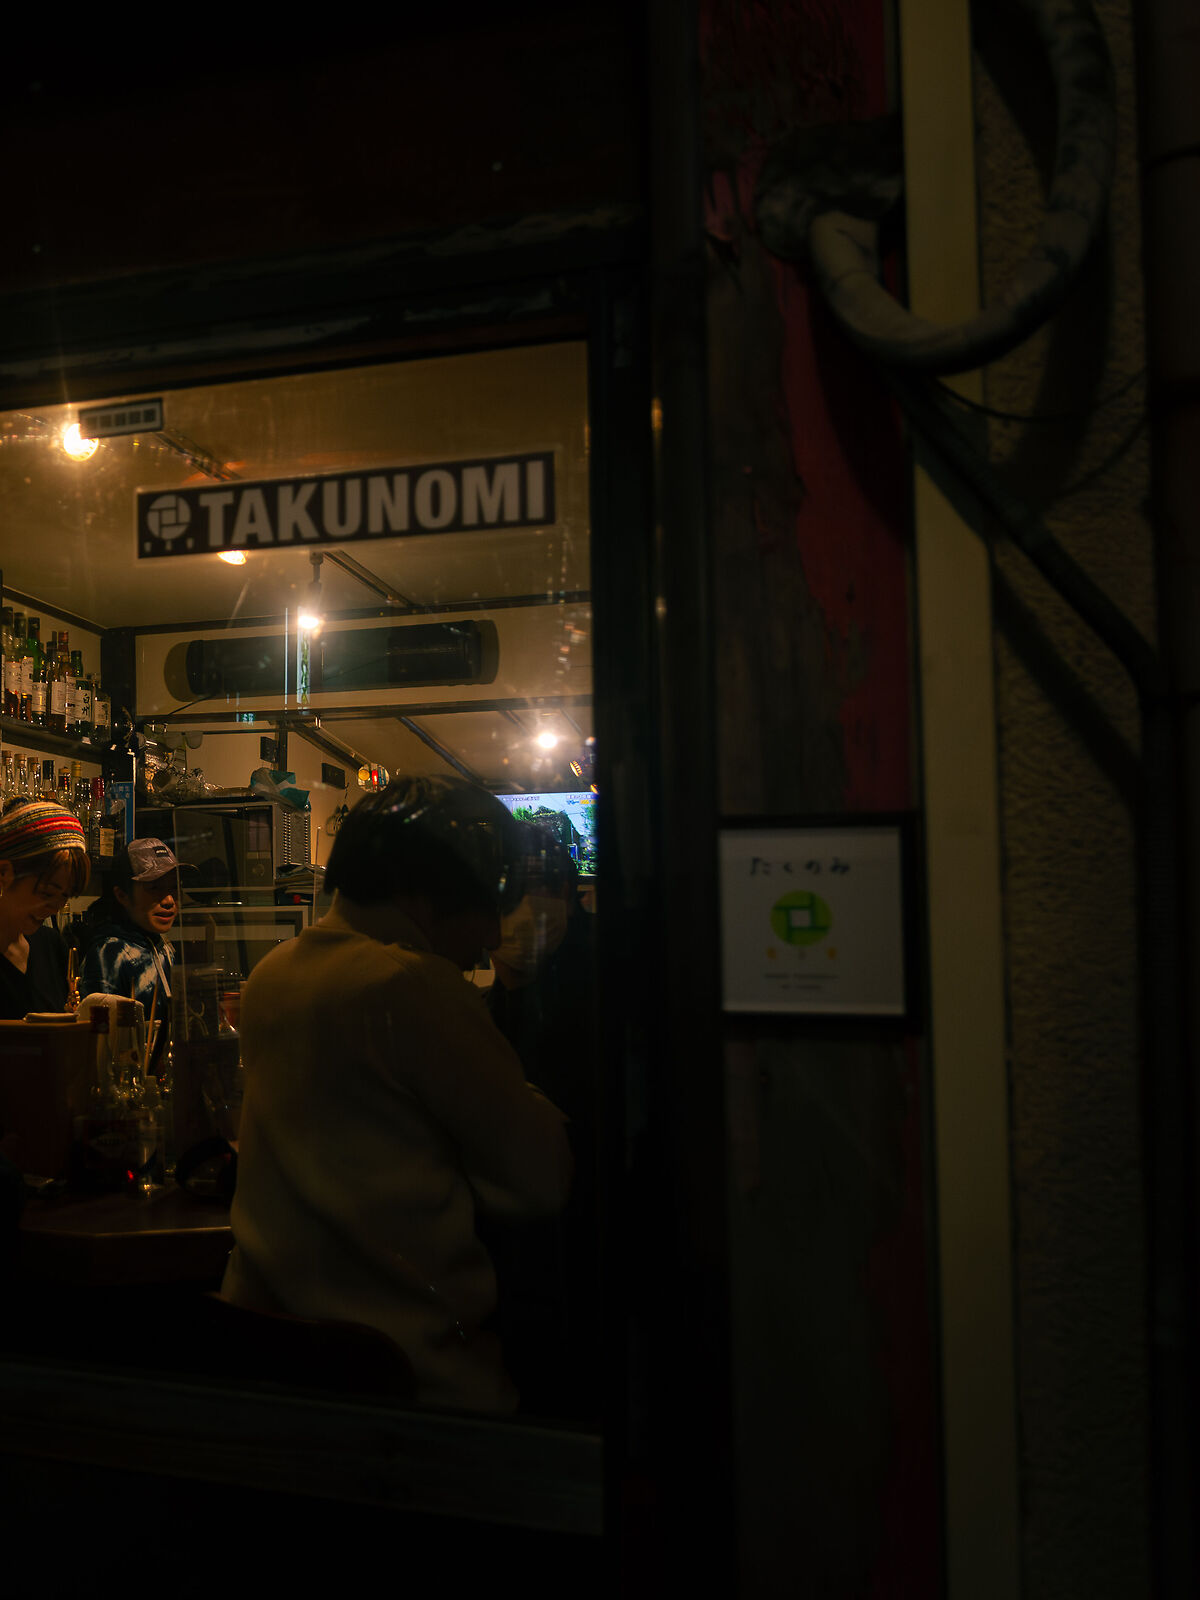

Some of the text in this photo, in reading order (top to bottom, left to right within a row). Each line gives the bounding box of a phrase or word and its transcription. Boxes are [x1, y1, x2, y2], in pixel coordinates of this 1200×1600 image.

[200, 457, 549, 549] TAKUNOMI
[81, 692, 91, 716] 白州
[750, 857, 850, 876] たくのみ
